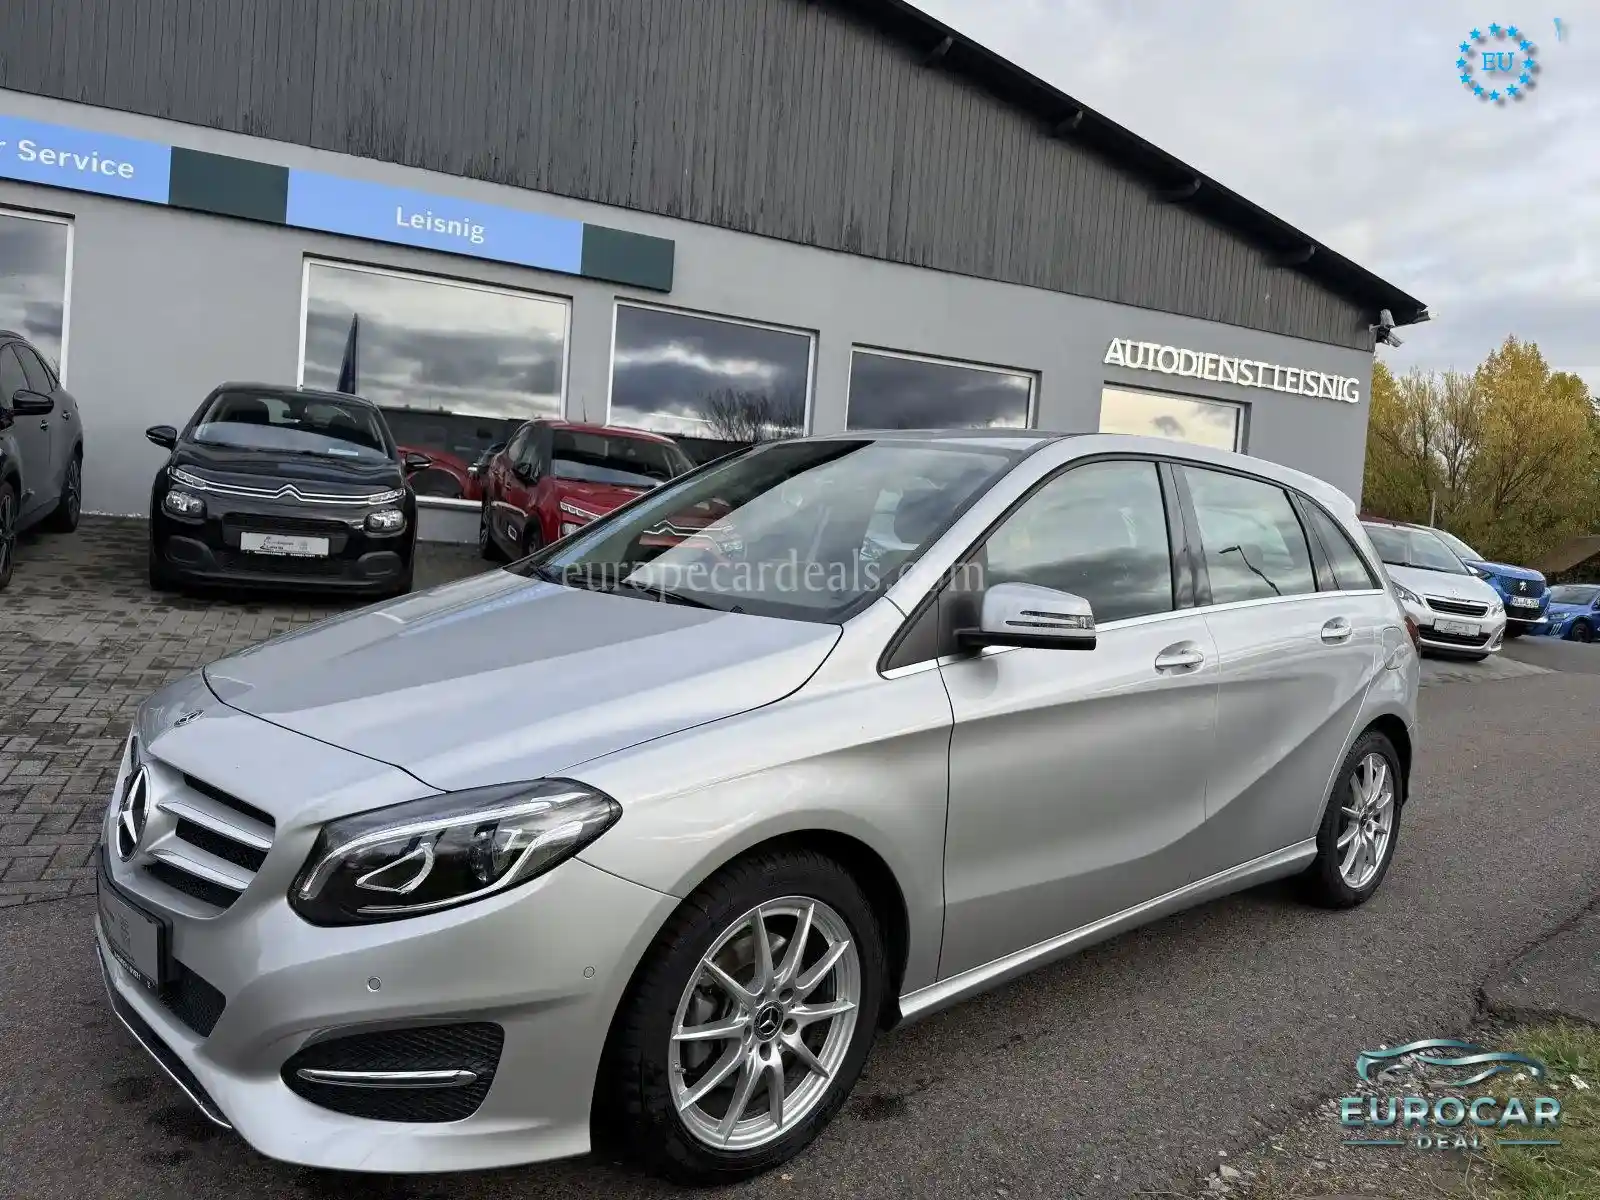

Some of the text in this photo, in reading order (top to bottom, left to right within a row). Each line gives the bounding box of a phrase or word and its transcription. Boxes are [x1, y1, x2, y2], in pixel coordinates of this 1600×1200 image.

[17, 139, 134, 179] Service
[396, 206, 485, 244] Leisnig
[1103, 337, 1360, 404] AUTODIENST LEISNIG
